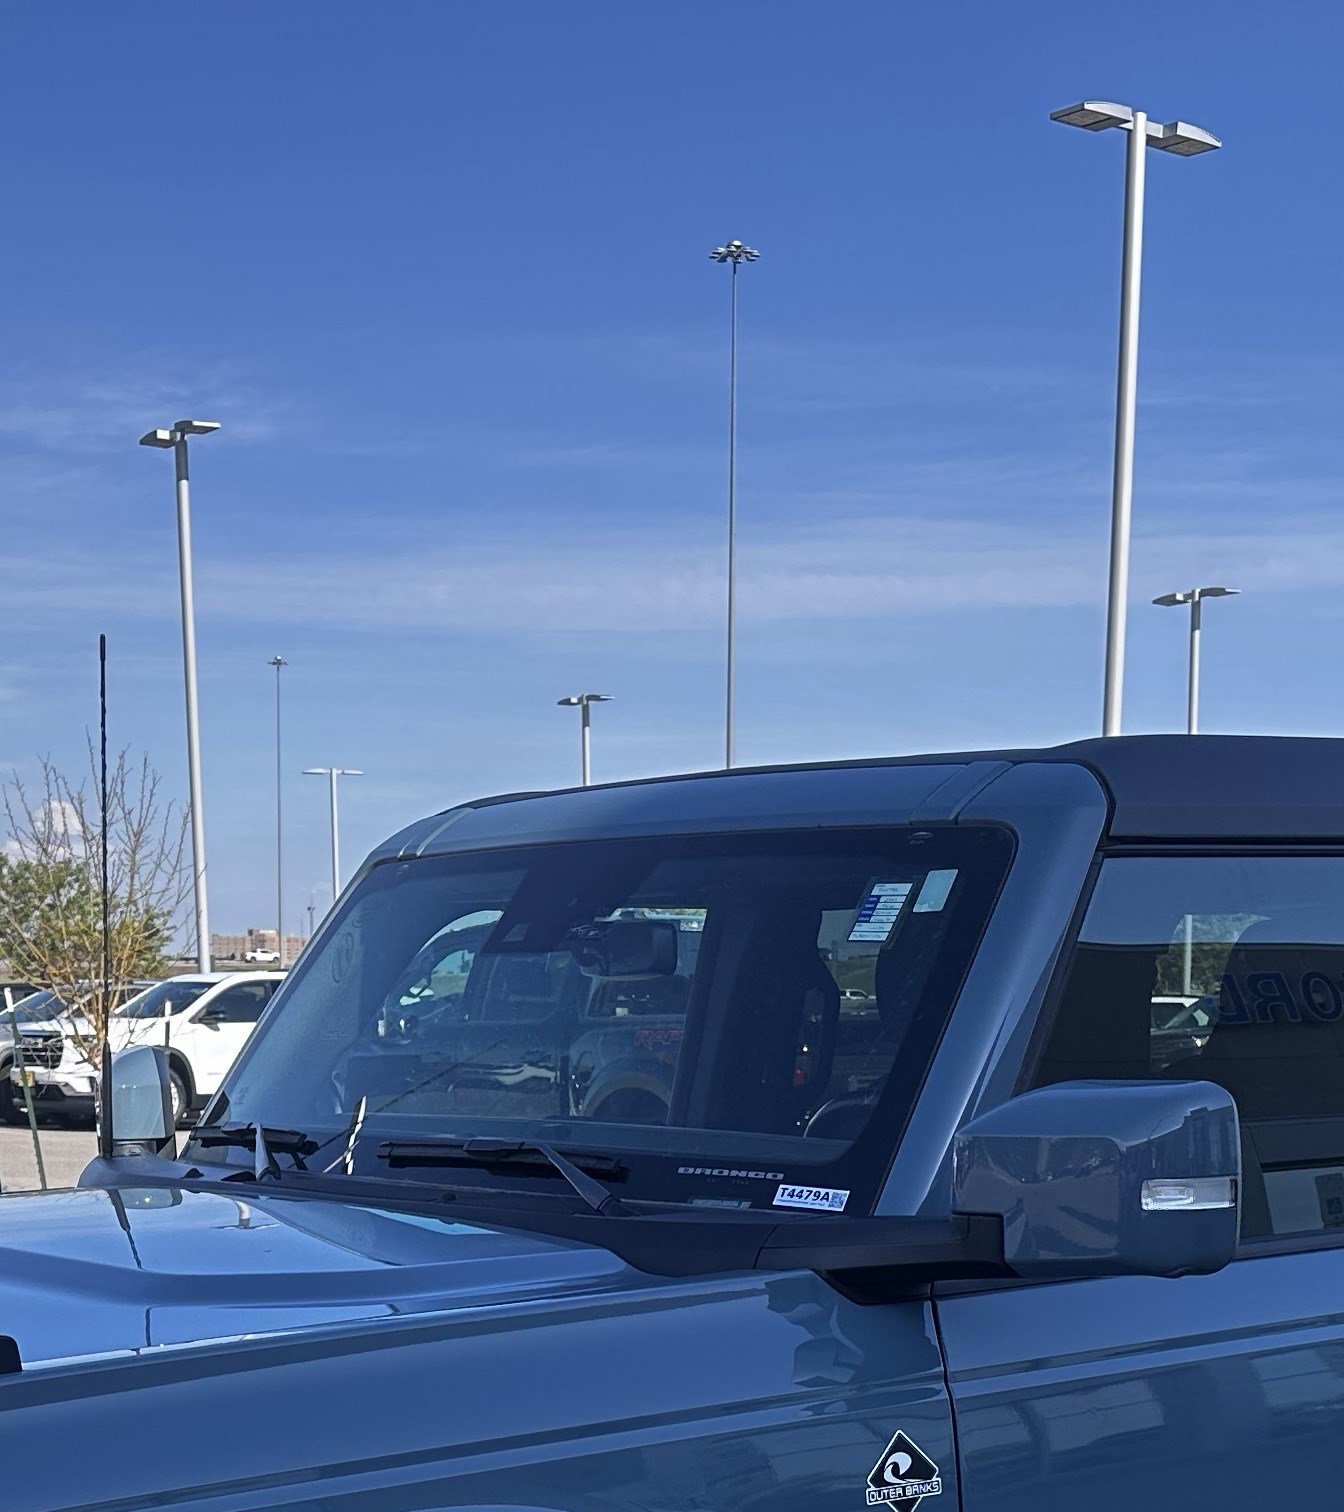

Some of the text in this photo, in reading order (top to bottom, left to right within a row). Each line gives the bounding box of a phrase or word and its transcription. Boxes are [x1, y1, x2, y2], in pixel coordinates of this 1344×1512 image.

[677, 1166, 784, 1180] BRONCO
[779, 1187, 830, 1202] T4479A
[869, 1481, 939, 1502] OUTER BANKS
